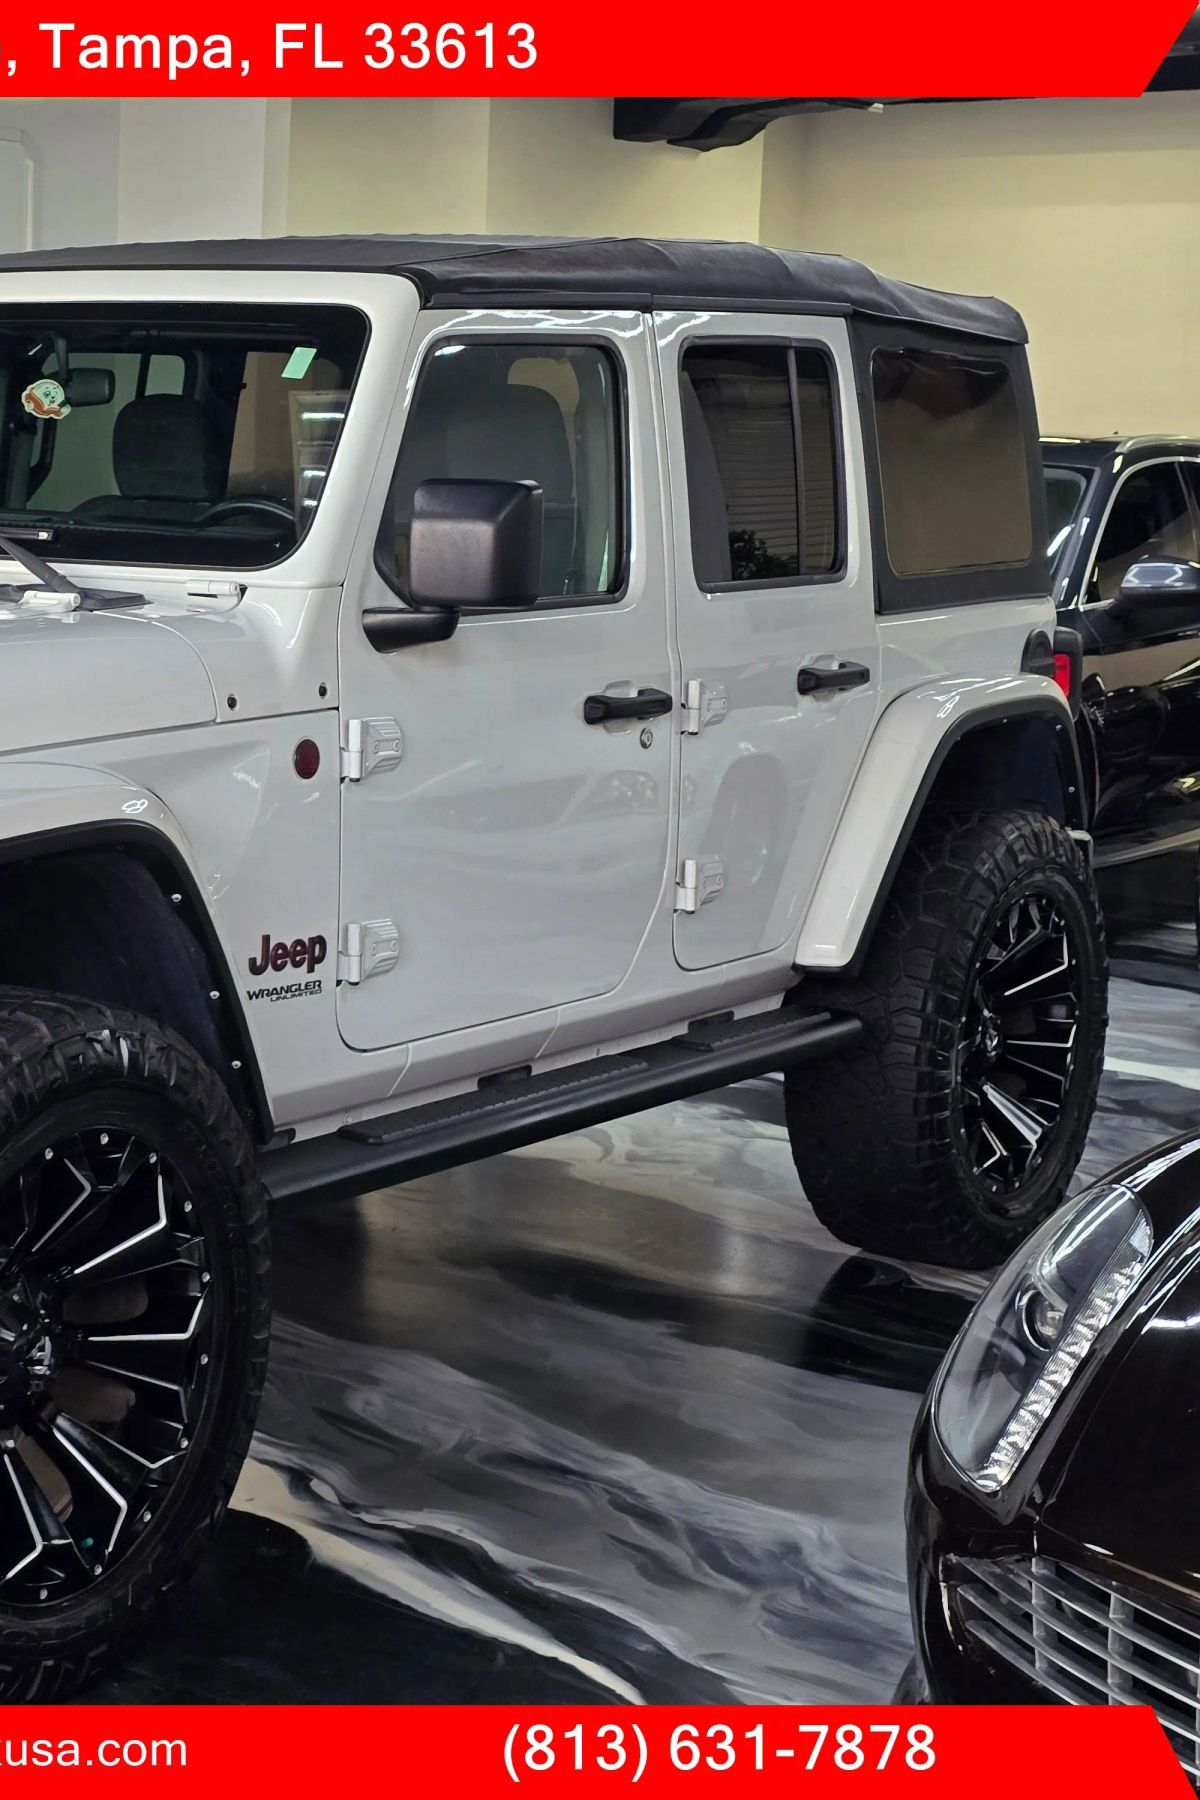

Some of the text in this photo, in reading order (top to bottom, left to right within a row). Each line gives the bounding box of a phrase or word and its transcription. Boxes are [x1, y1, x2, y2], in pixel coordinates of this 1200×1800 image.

[248, 934, 328, 976] Jeep
[246, 979, 322, 1001] WRANGLER
[270, 989, 323, 1003] UNLIMITED
